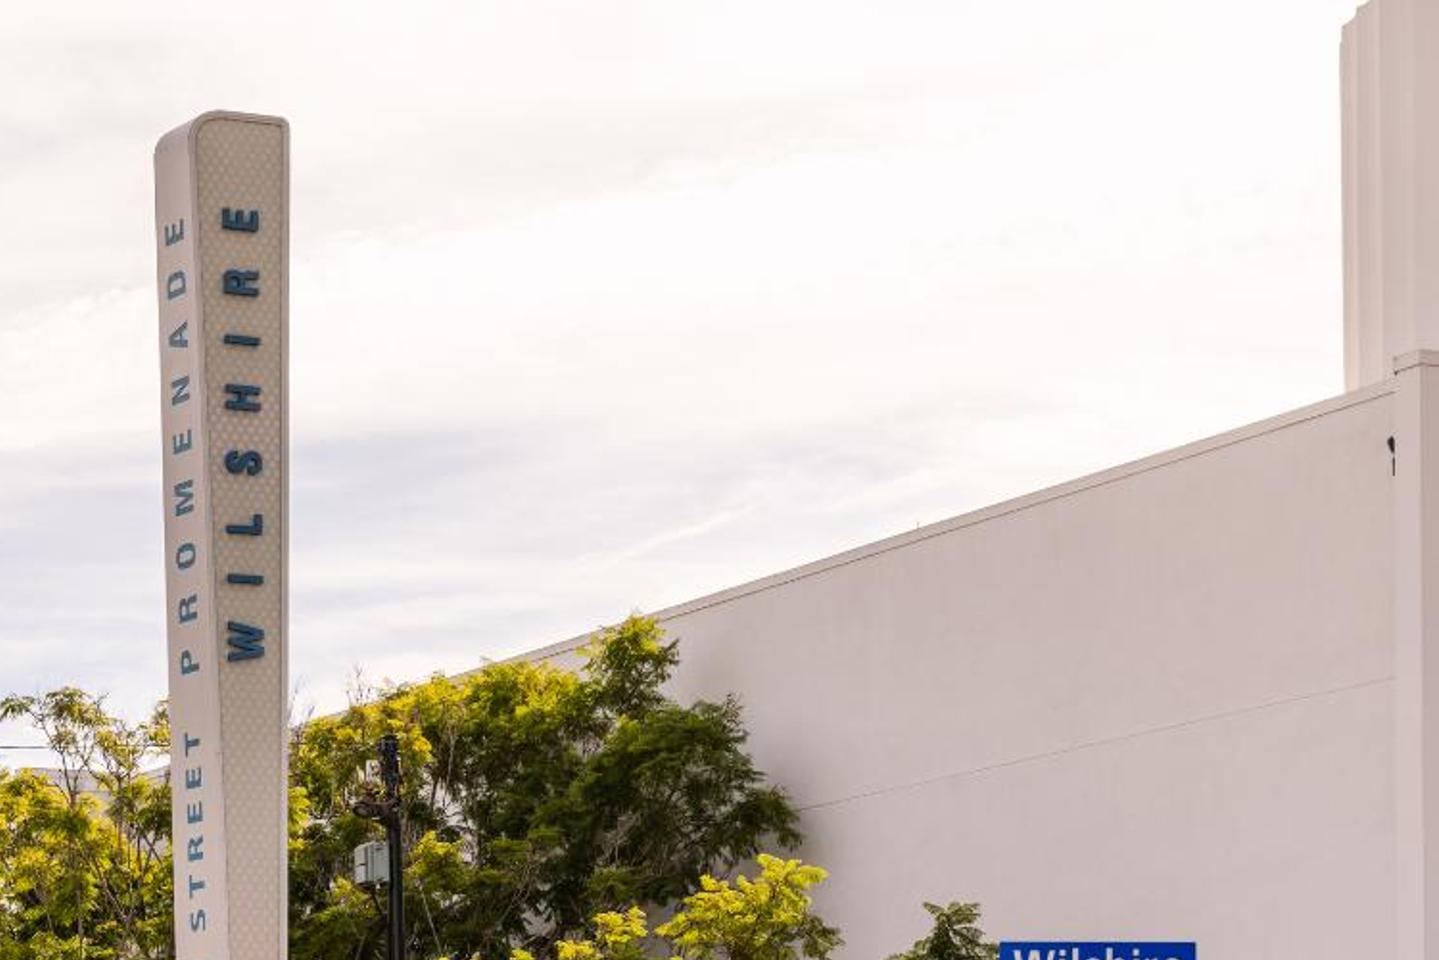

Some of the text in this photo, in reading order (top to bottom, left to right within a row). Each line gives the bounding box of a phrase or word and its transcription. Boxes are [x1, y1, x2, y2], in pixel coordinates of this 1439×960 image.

[164, 217, 200, 676] PROMENADE
[221, 207, 266, 665] WILSHIRE
[183, 731, 208, 932] STREET
